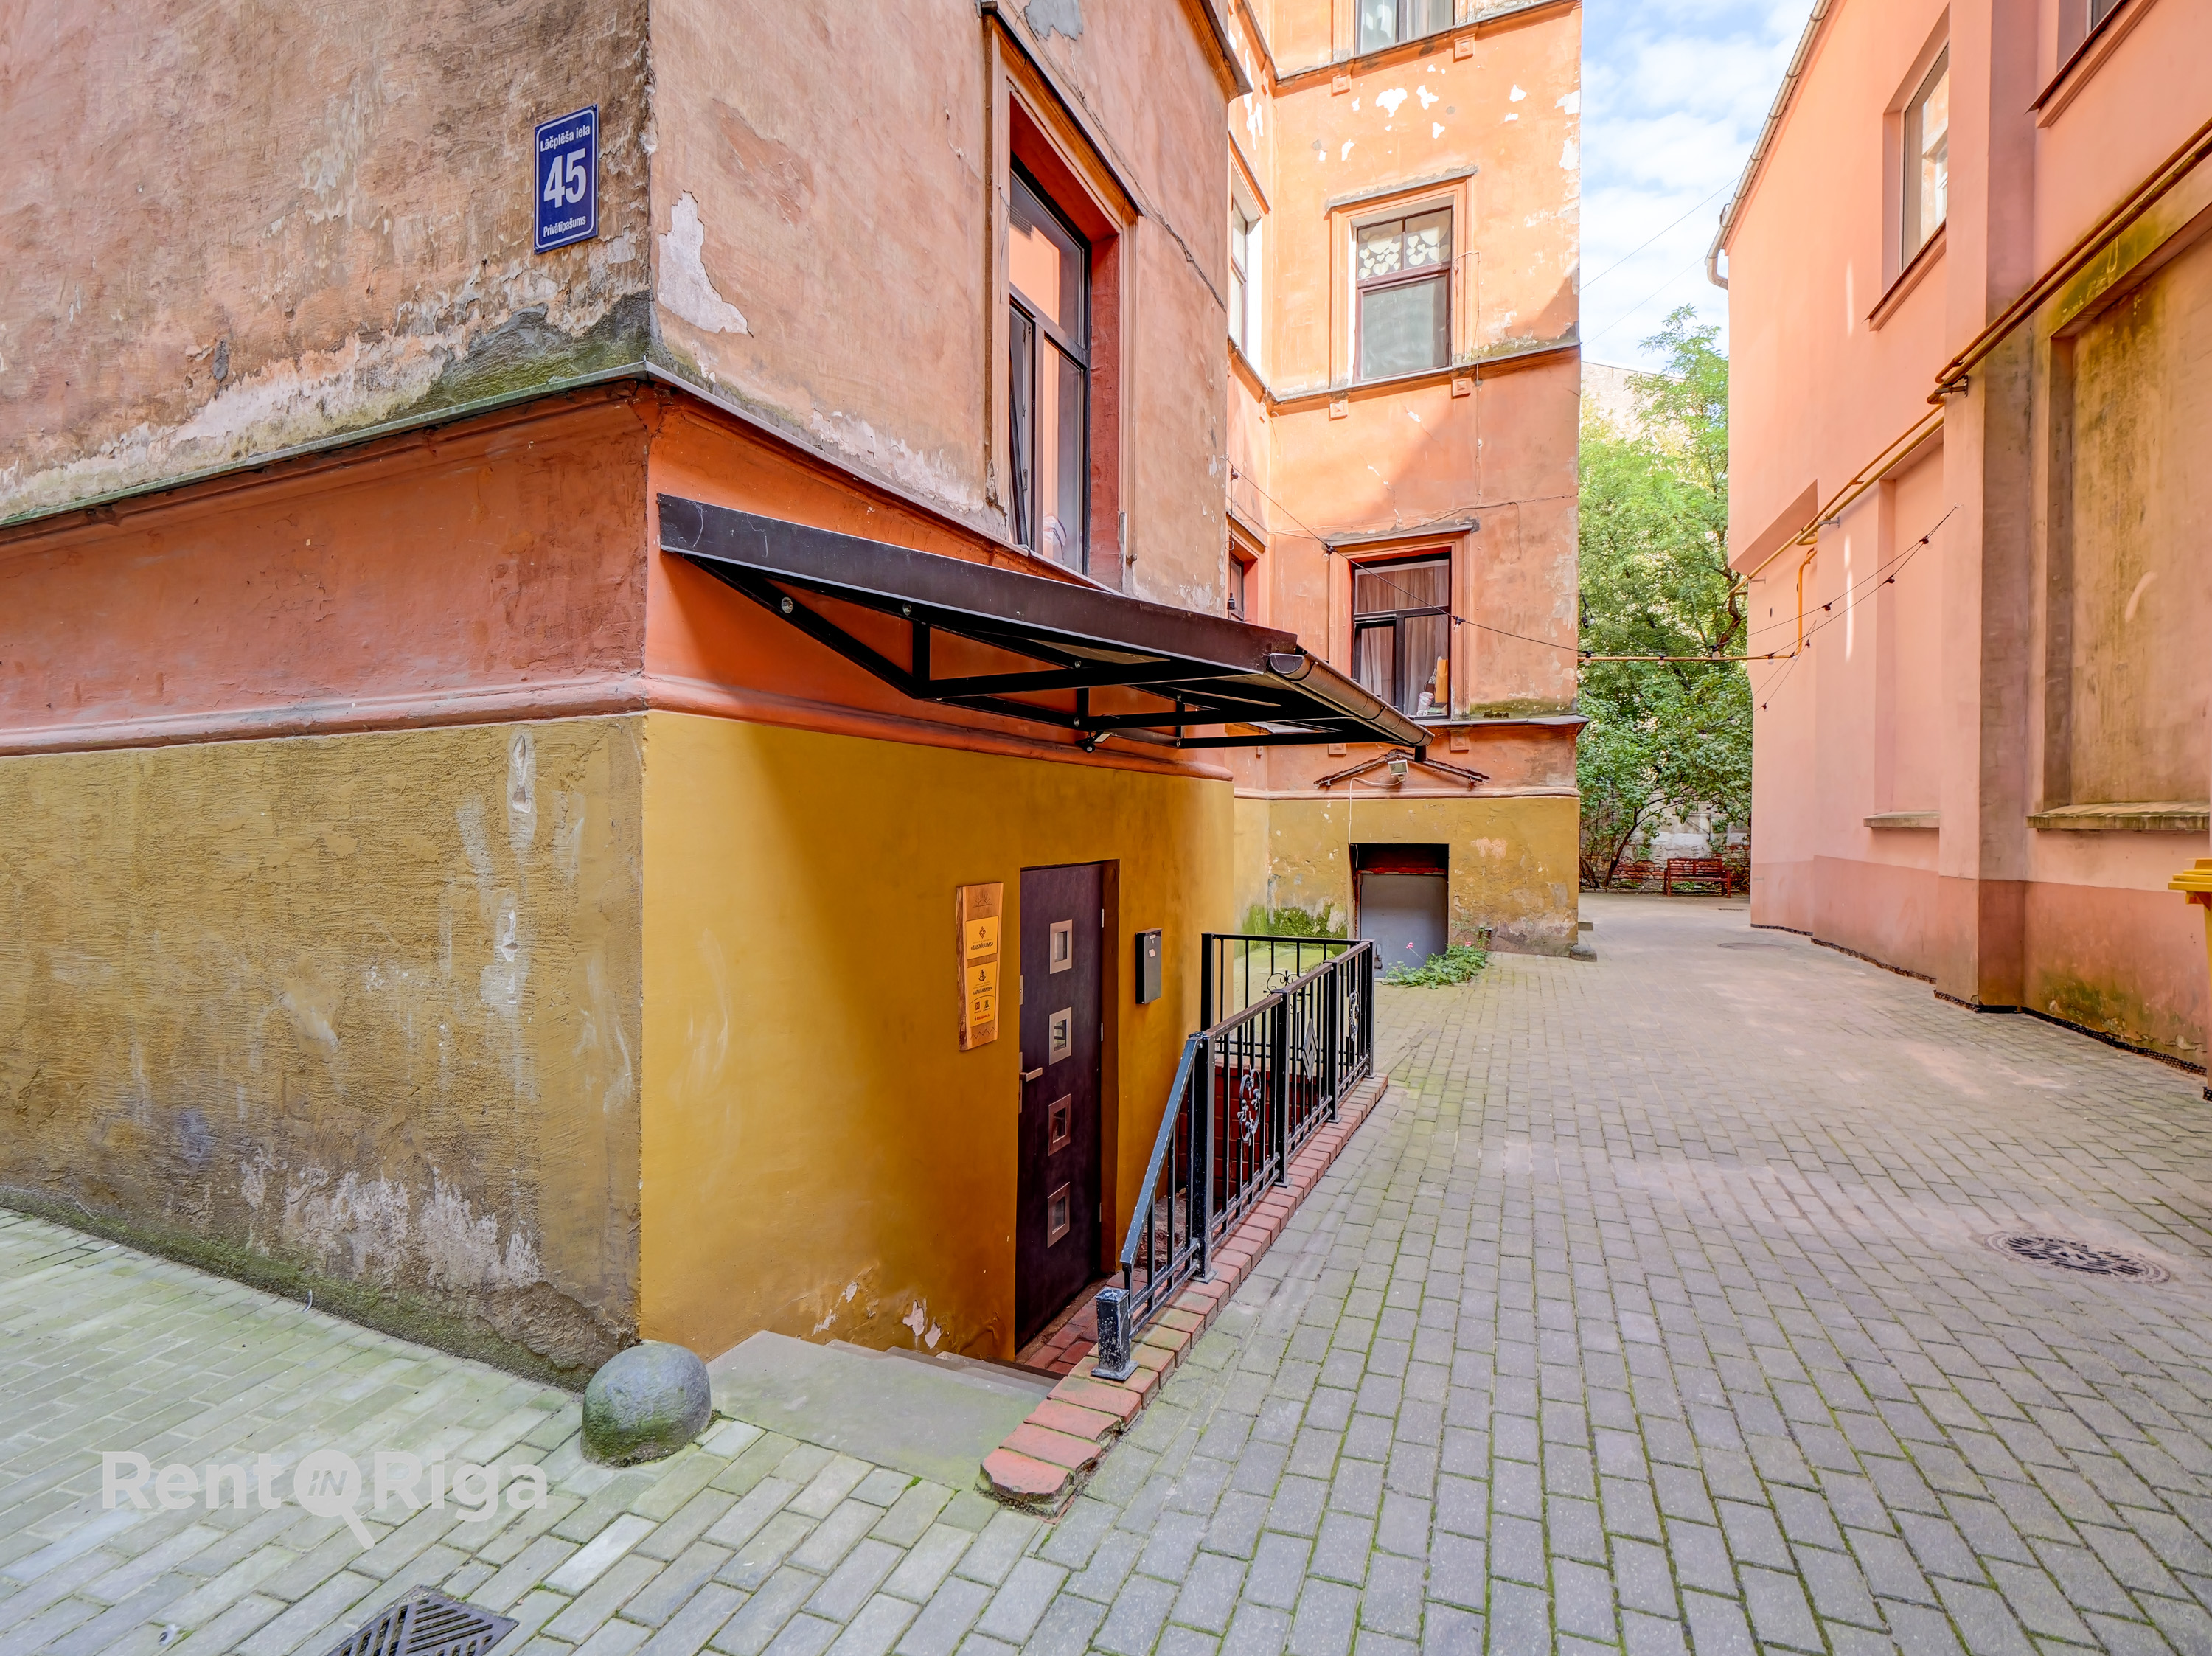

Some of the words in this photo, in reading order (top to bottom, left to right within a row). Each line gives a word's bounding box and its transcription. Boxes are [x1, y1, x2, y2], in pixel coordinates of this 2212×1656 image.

[540, 130, 574, 152] Lāčplēša
[576, 125, 591, 139] iela
[543, 147, 587, 209] 45
[543, 216, 586, 237] Privātīpašums
